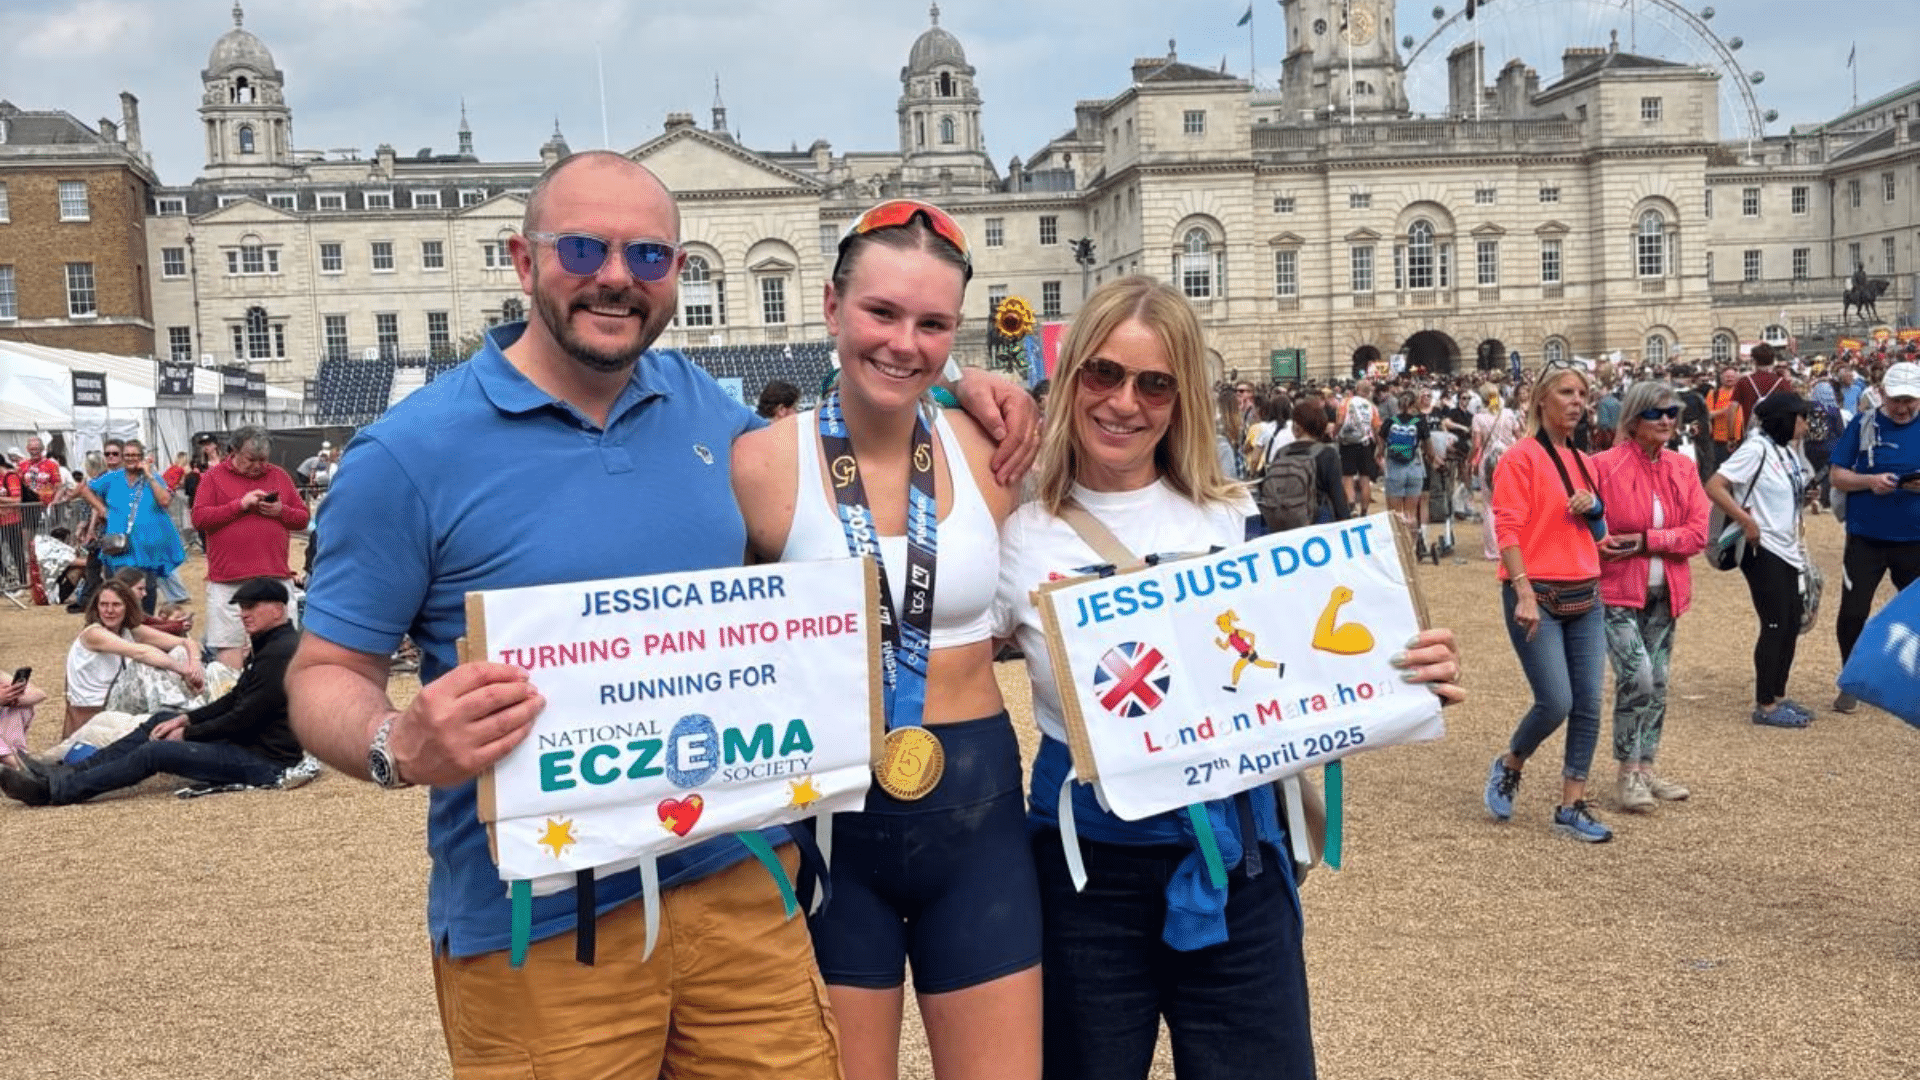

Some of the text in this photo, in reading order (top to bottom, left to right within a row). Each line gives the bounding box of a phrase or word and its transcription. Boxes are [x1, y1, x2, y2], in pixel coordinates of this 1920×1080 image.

[846, 504, 875, 556] 2025
[915, 496, 929, 545] FINISHER
[580, 575, 786, 618] JESSICA BARR
[1076, 523, 1374, 628] JESS JUST DO IT
[500, 613, 859, 671] TURNING PAIN INTO PRIDE
[600, 664, 777, 705] RUNNING FOR
[538, 720, 663, 750] NATIONAL
[538, 717, 815, 792] ECZEMA
[1183, 726, 1366, 786] 27th April 2025
[723, 757, 814, 782] SOCIETY
